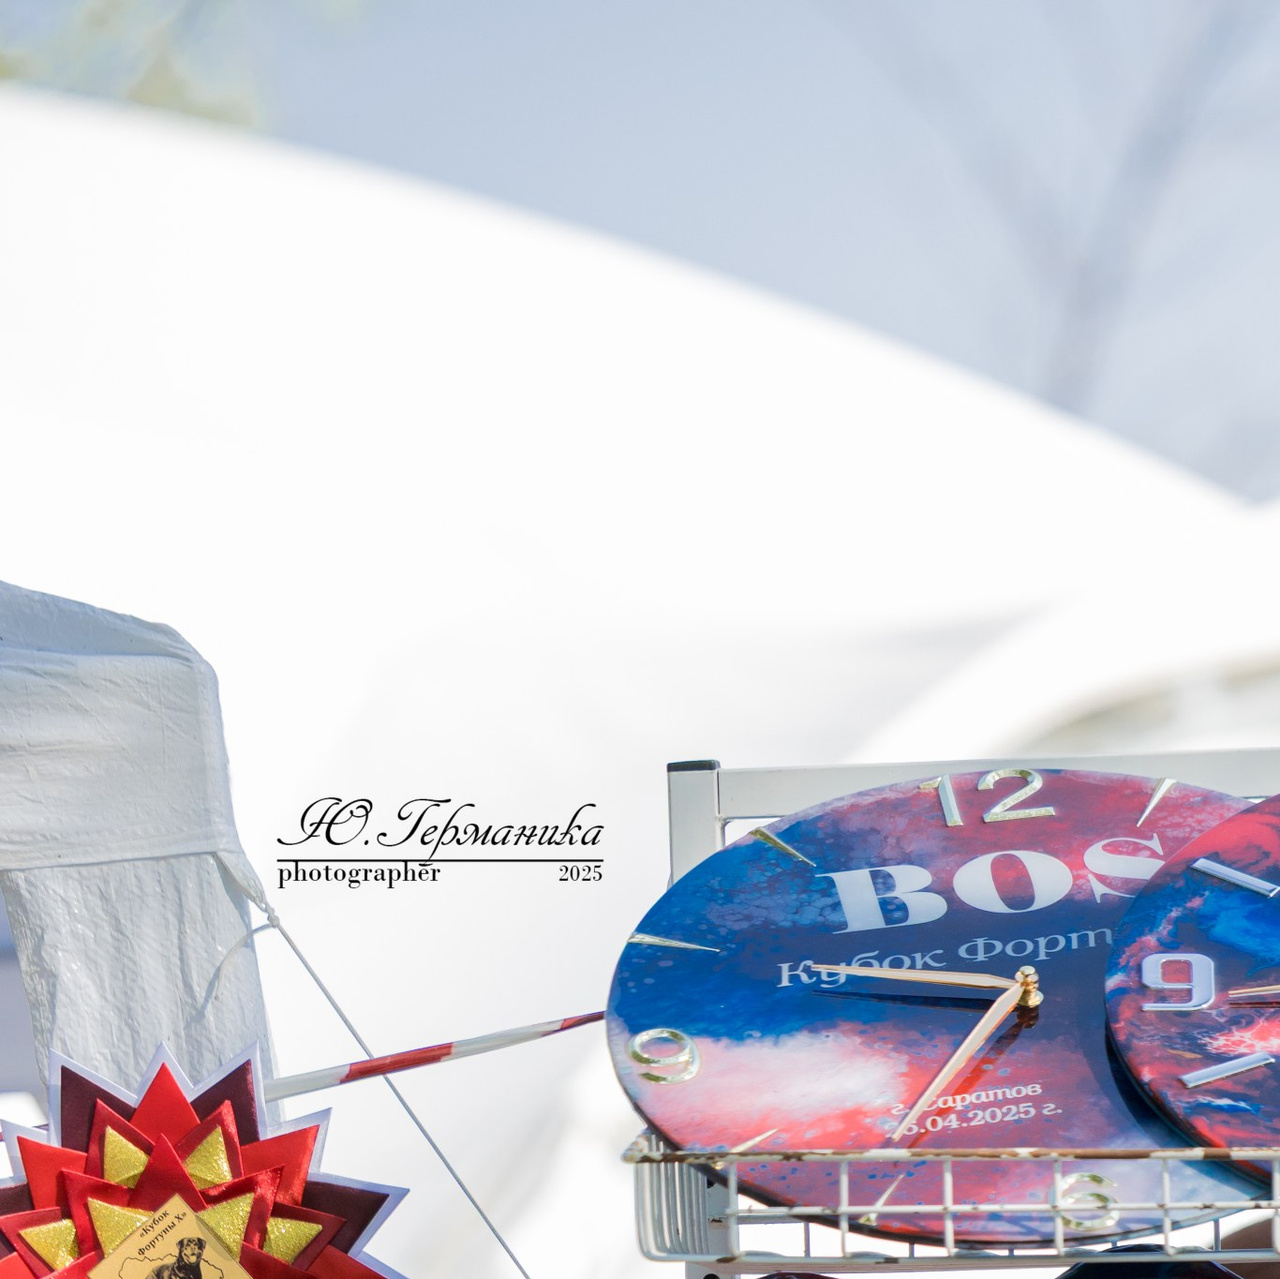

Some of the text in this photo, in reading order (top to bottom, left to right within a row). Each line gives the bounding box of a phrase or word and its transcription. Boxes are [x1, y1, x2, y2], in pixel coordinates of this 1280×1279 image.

[919, 767, 1056, 828] 12
[814, 832, 1168, 934] BOS
[958, 928, 1114, 962] Форт
[1140, 952, 1217, 1012] 9
[628, 1027, 701, 1085] 9
[886, 1103, 1036, 1138] 6.04.2025
[1055, 1171, 1120, 1232] 6
